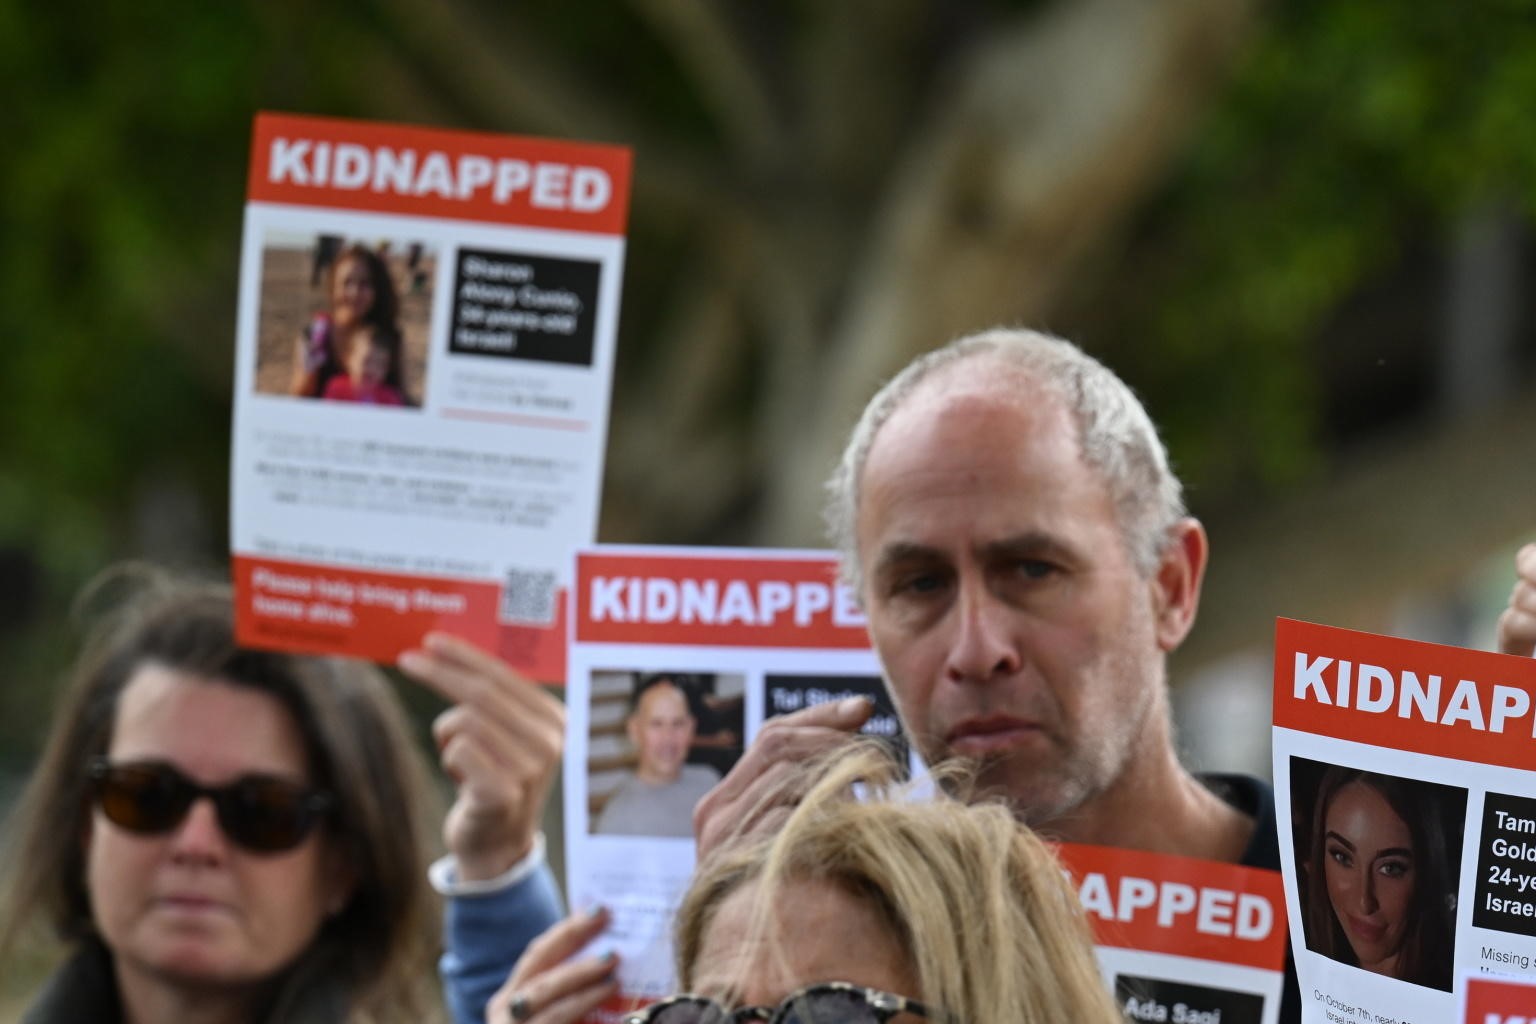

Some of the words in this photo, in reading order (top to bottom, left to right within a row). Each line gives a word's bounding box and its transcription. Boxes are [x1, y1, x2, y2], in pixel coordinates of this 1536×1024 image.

[268, 138, 612, 213] KIDNAPPED
[590, 576, 868, 627] KIDNAPPE
[1079, 872, 1274, 941] APPED
[1481, 947, 1529, 969] Missing
[1124, 997, 1168, 1021] Ada
[1314, 989, 1325, 1001] On
[1326, 994, 1355, 1015] October
[1358, 1007, 1373, 1022] 7th,
